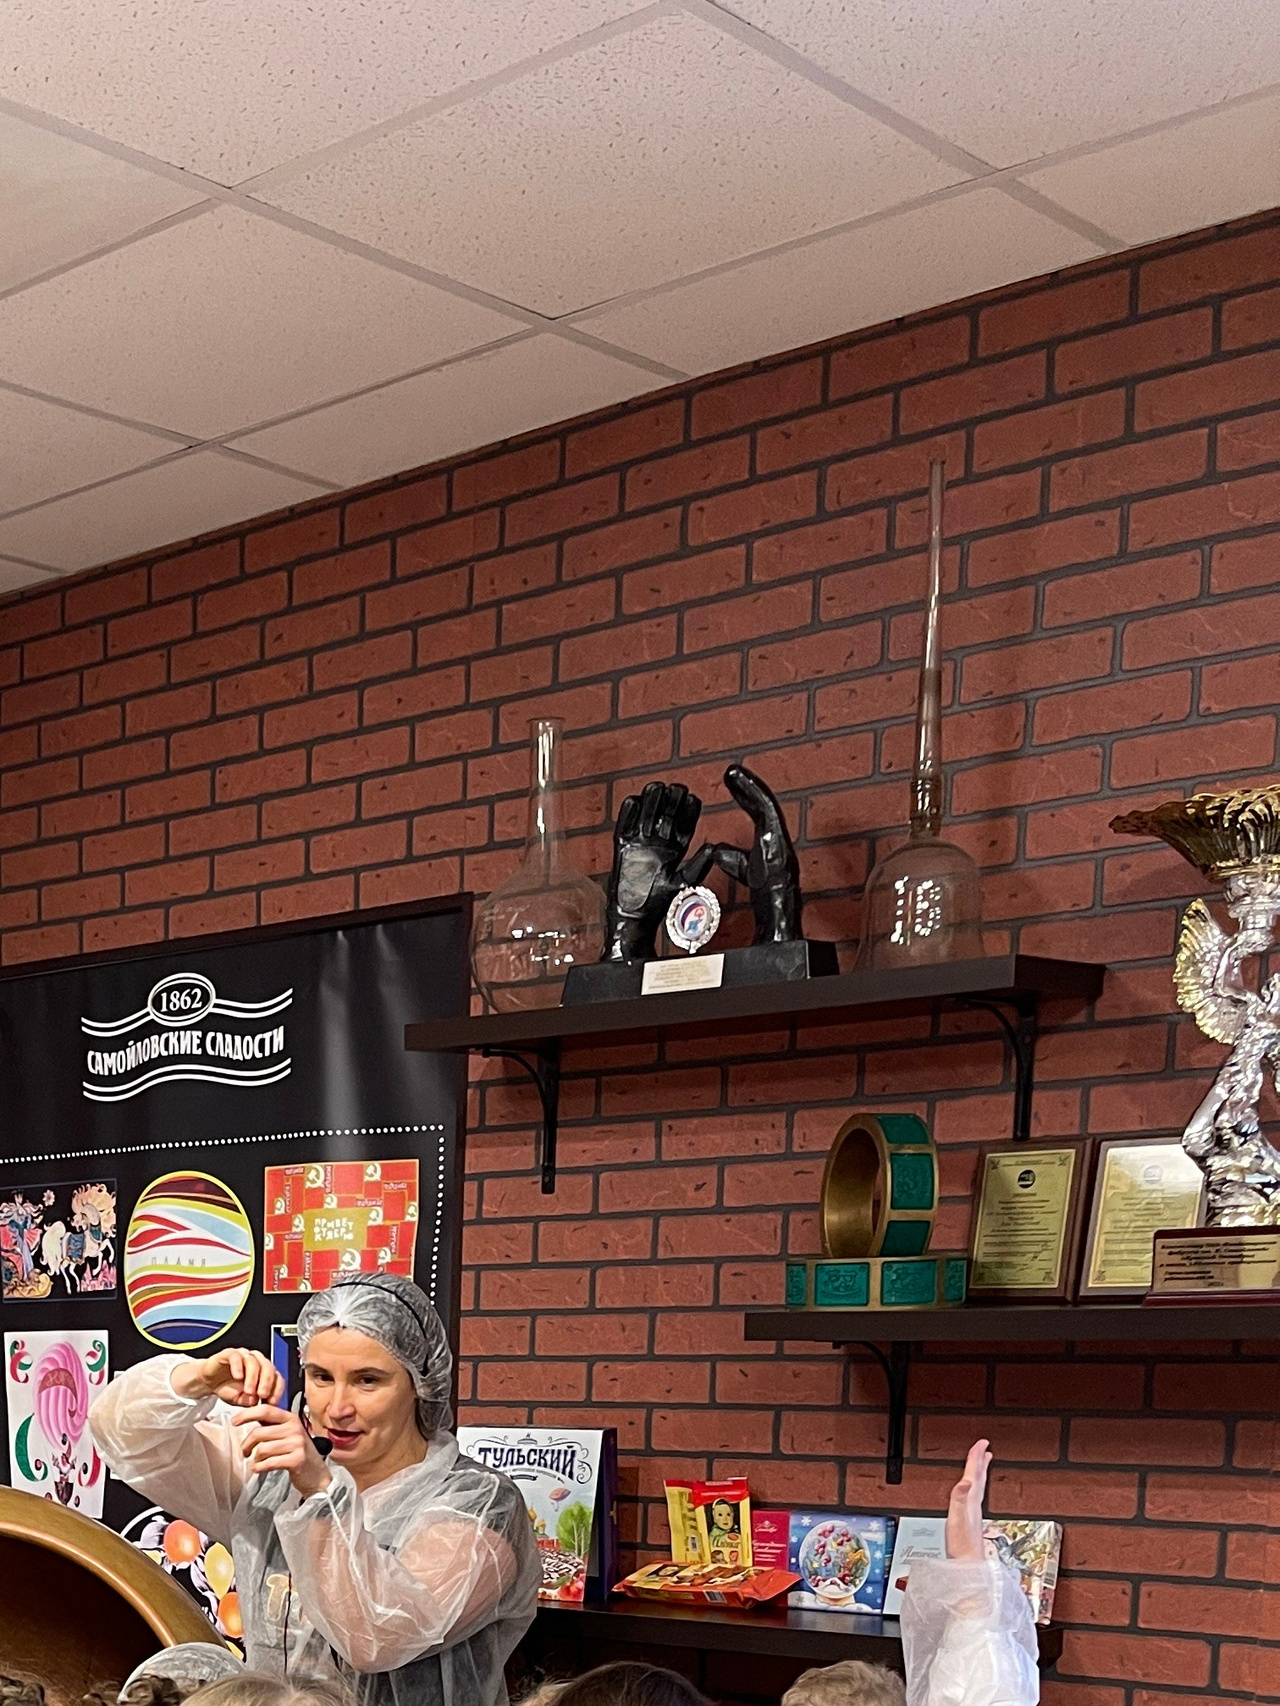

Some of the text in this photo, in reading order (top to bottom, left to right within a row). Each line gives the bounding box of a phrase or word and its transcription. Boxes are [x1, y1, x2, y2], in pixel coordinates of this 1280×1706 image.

[160, 988, 202, 1012] 1862
[87, 1025, 284, 1076] САМОЙЛОВСКИЕ СЛАДОСТИ
[478, 1445, 577, 1481] ТУЛЬСКИЙ
